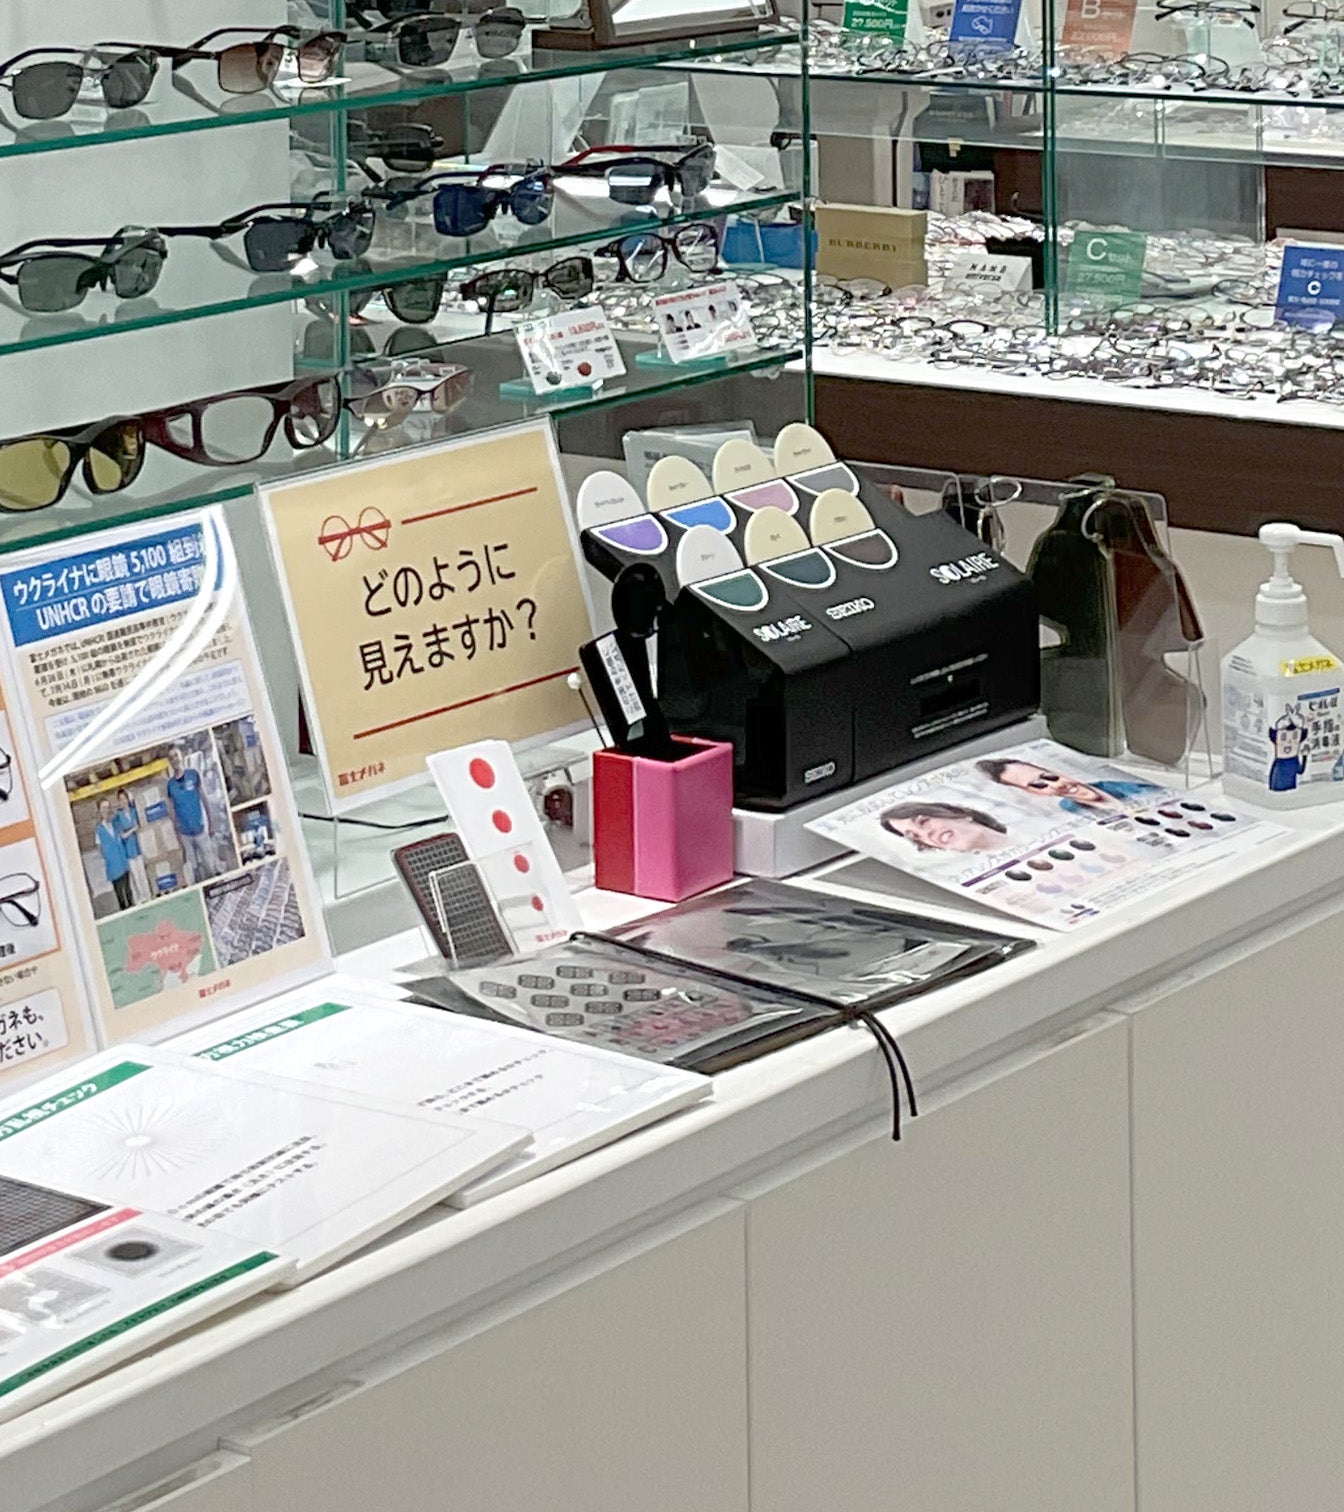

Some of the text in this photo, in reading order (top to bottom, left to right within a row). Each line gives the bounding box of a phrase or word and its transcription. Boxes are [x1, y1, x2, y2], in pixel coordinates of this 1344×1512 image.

[828, 239, 897, 253] BURBERRY
[14, 554, 130, 605] ウクライナに眼鏡
[130, 545, 167, 575] 5,100
[362, 543, 515, 617] どのように
[930, 552, 999, 584] SOLAIRE
[36, 598, 88, 631] UNHCR
[826, 597, 875, 619] SEIKO
[359, 598, 537, 691] 見えますか？
[753, 614, 812, 643] SOLAIRE
[338, 761, 386, 787] 富士メガネ
